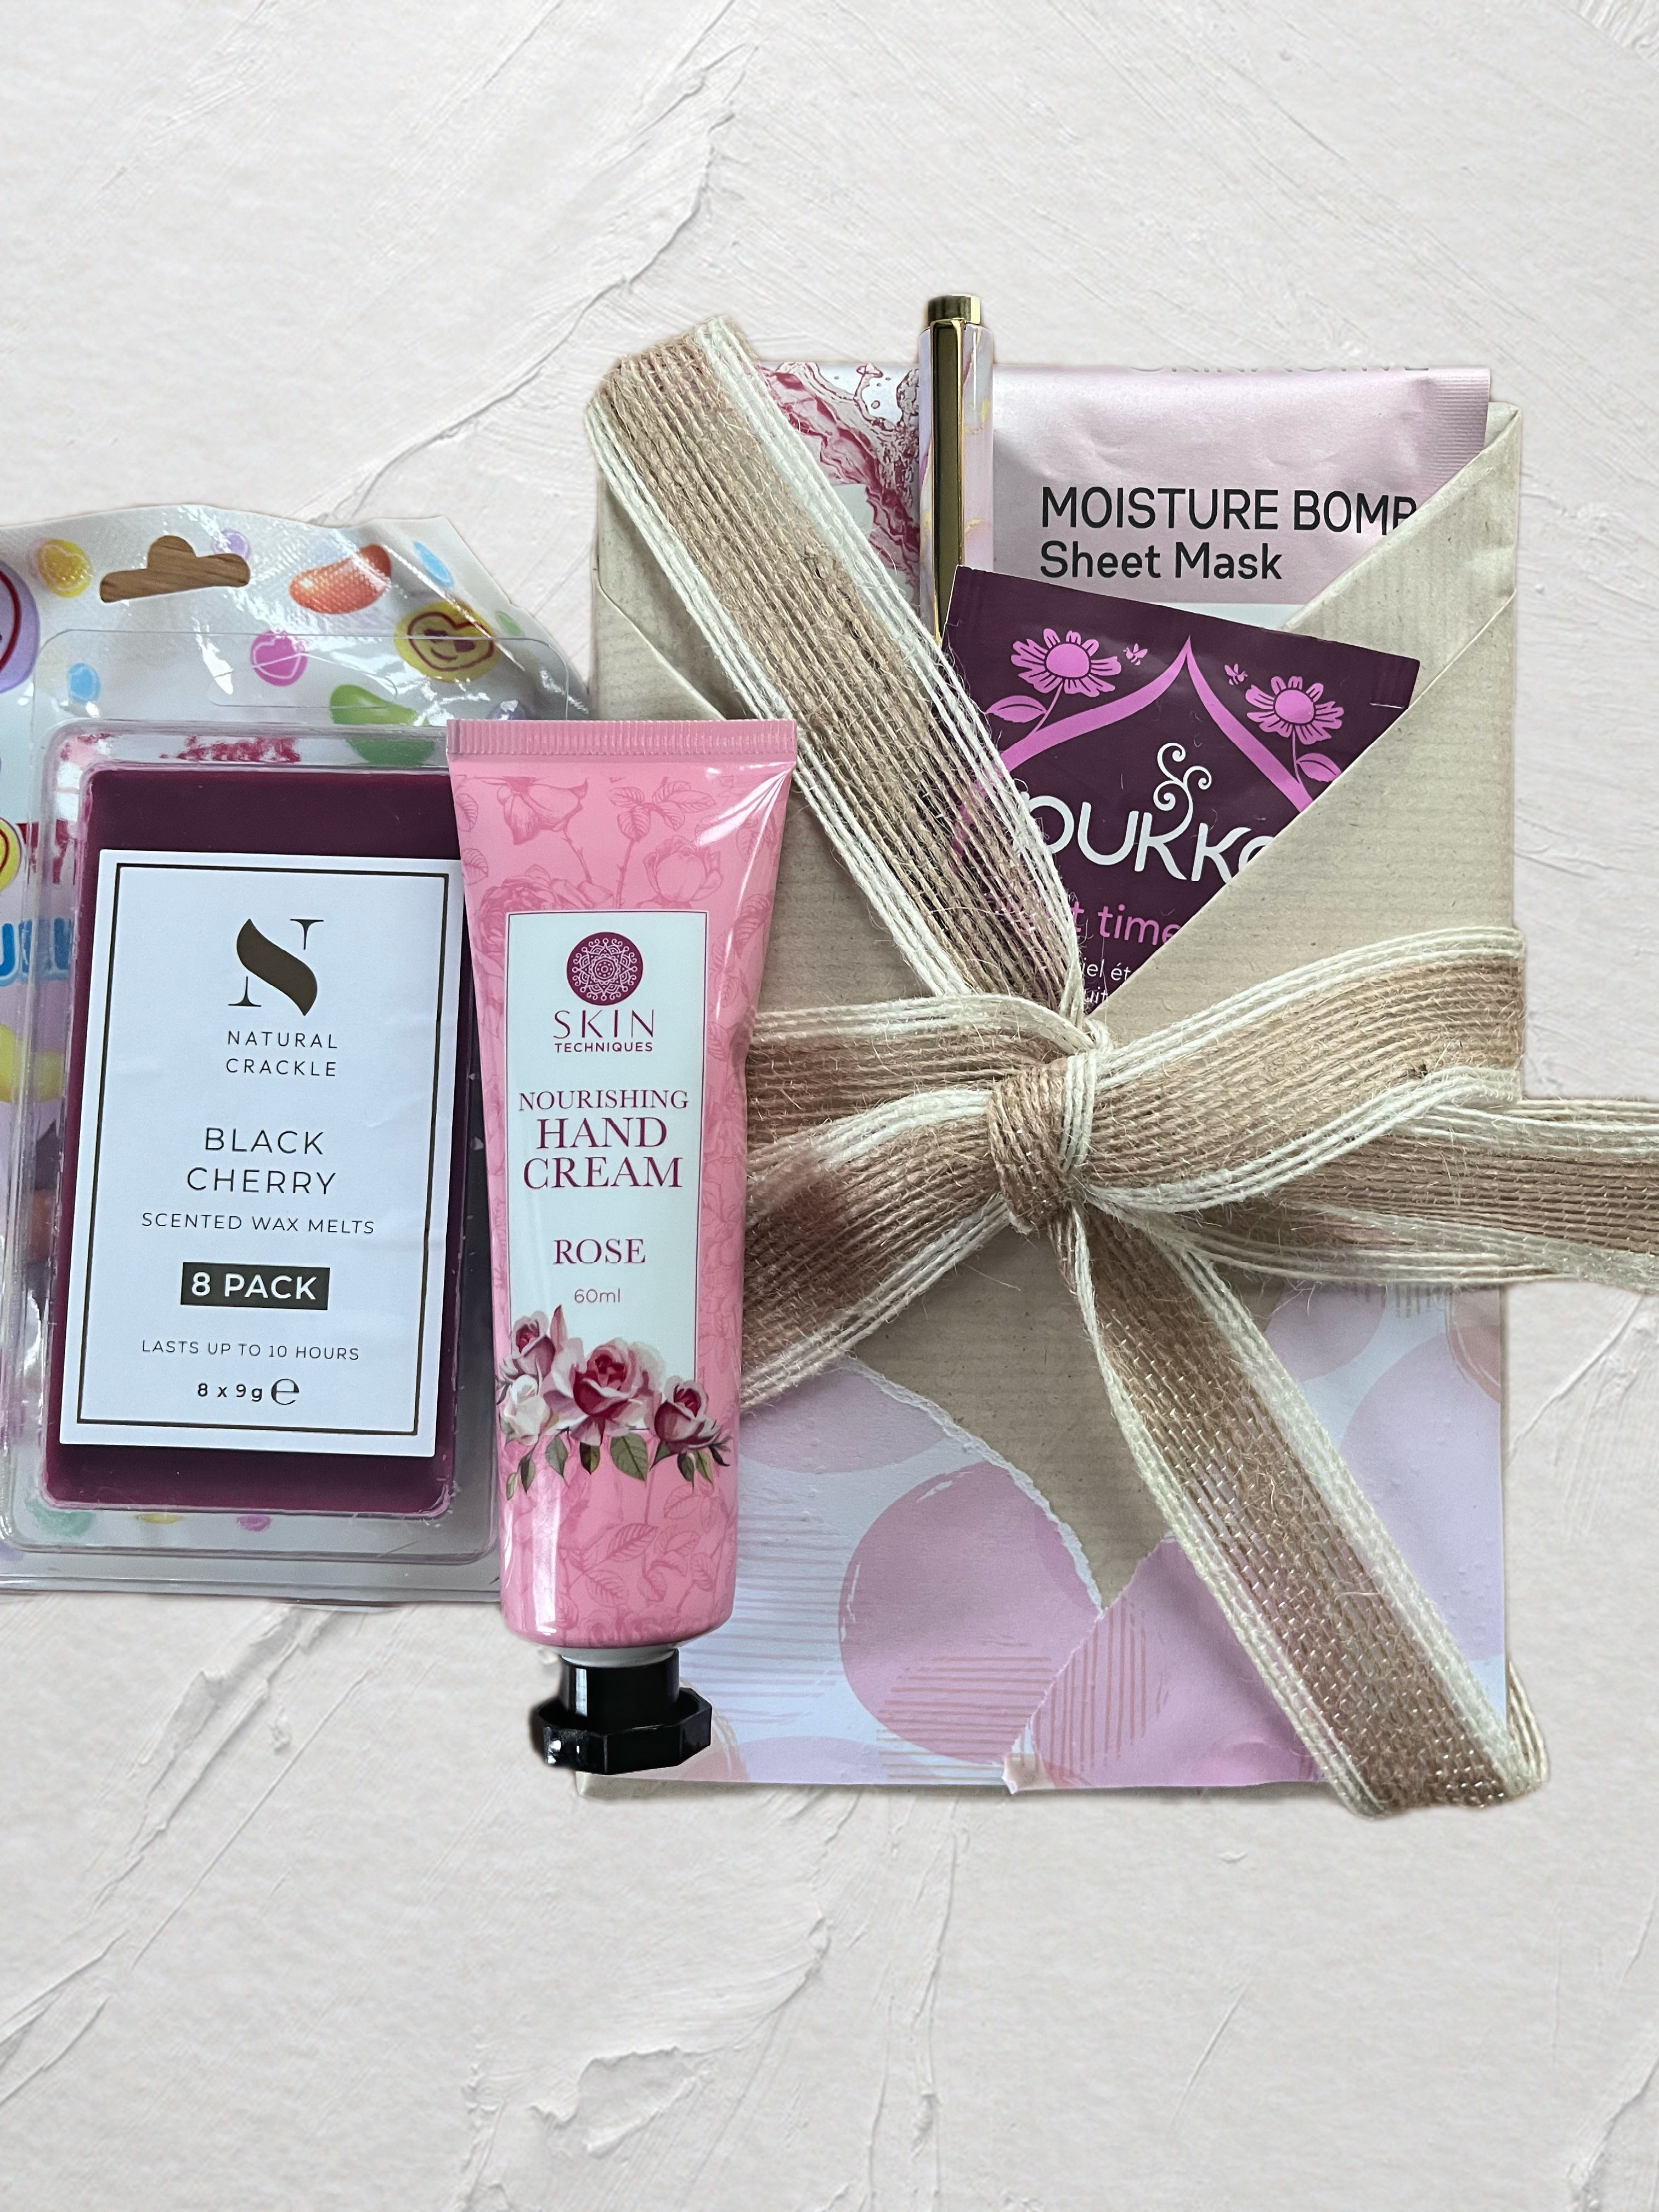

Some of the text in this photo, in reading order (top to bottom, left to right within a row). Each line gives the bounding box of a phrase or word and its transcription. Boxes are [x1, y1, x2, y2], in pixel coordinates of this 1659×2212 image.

[1040, 486, 1279, 531] MOISTURE
[1040, 540, 1283, 580] Sheet Mask
[553, 1009, 654, 1039] SKIN
[228, 1030, 338, 1049] NATURAL
[554, 1041, 653, 1053] TECHNIQUES
[225, 1058, 337, 1077] CRACKLE
[518, 1090, 689, 1111] NOURISHING
[205, 1127, 324, 1155] BLACK
[536, 1116, 668, 1150] HAND
[187, 1167, 336, 1195] CHERRY
[523, 1156, 684, 1190] CREAM
[142, 1212, 375, 1235] SCENTED WAX MELTS
[553, 1238, 646, 1265] ROSE
[191, 1272, 317, 1300] 8 PACK
[574, 1288, 621, 1304] 60ml
[142, 1340, 360, 1361] LASTS UP TO 10 HOURS
[197, 1383, 208, 1398] 8
[217, 1386, 228, 1398] x
[236, 1383, 263, 1403] 9g
